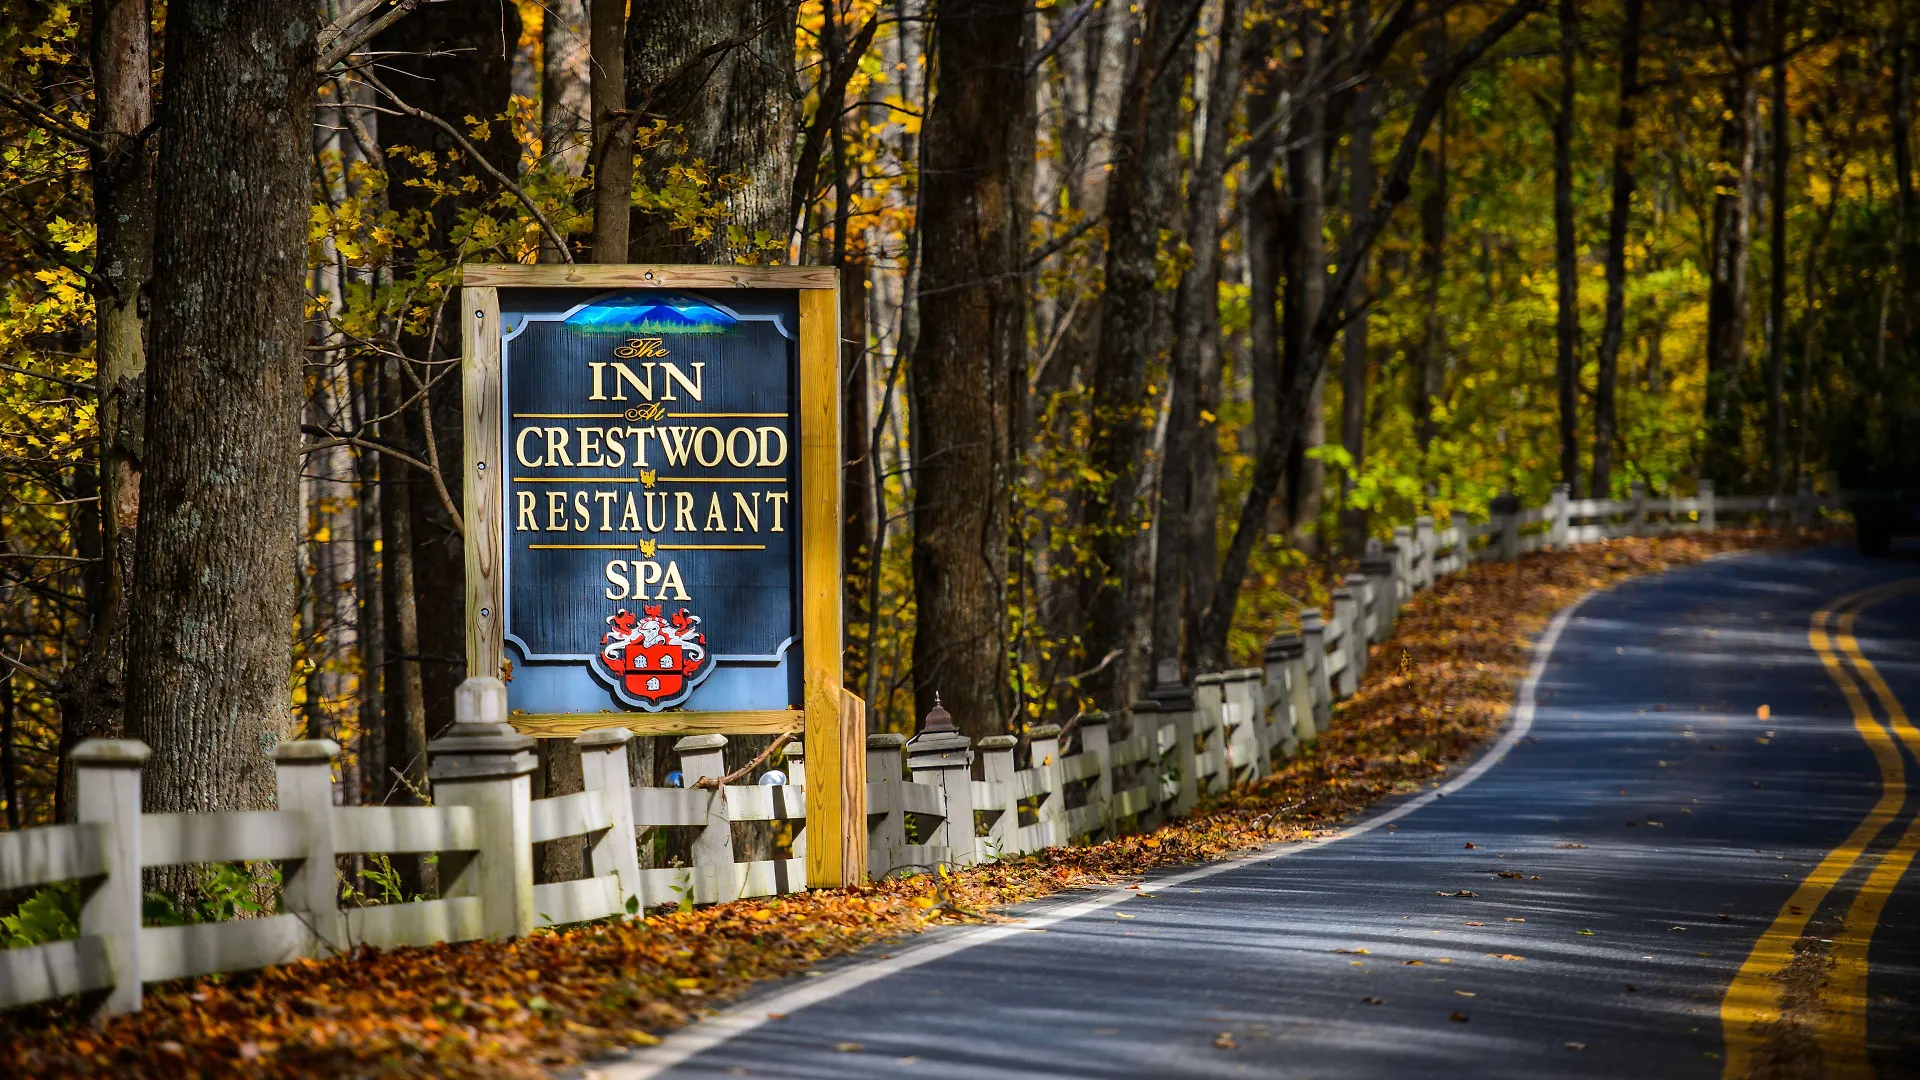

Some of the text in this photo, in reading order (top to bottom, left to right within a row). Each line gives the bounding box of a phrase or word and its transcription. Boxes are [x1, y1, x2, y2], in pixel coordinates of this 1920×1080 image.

[614, 338, 671, 358] The
[588, 362, 705, 401] INN
[625, 402, 665, 421] At
[516, 426, 788, 467] CRESTWOOD
[516, 491, 788, 532] RESTAURANT
[605, 560, 691, 601] SPA
